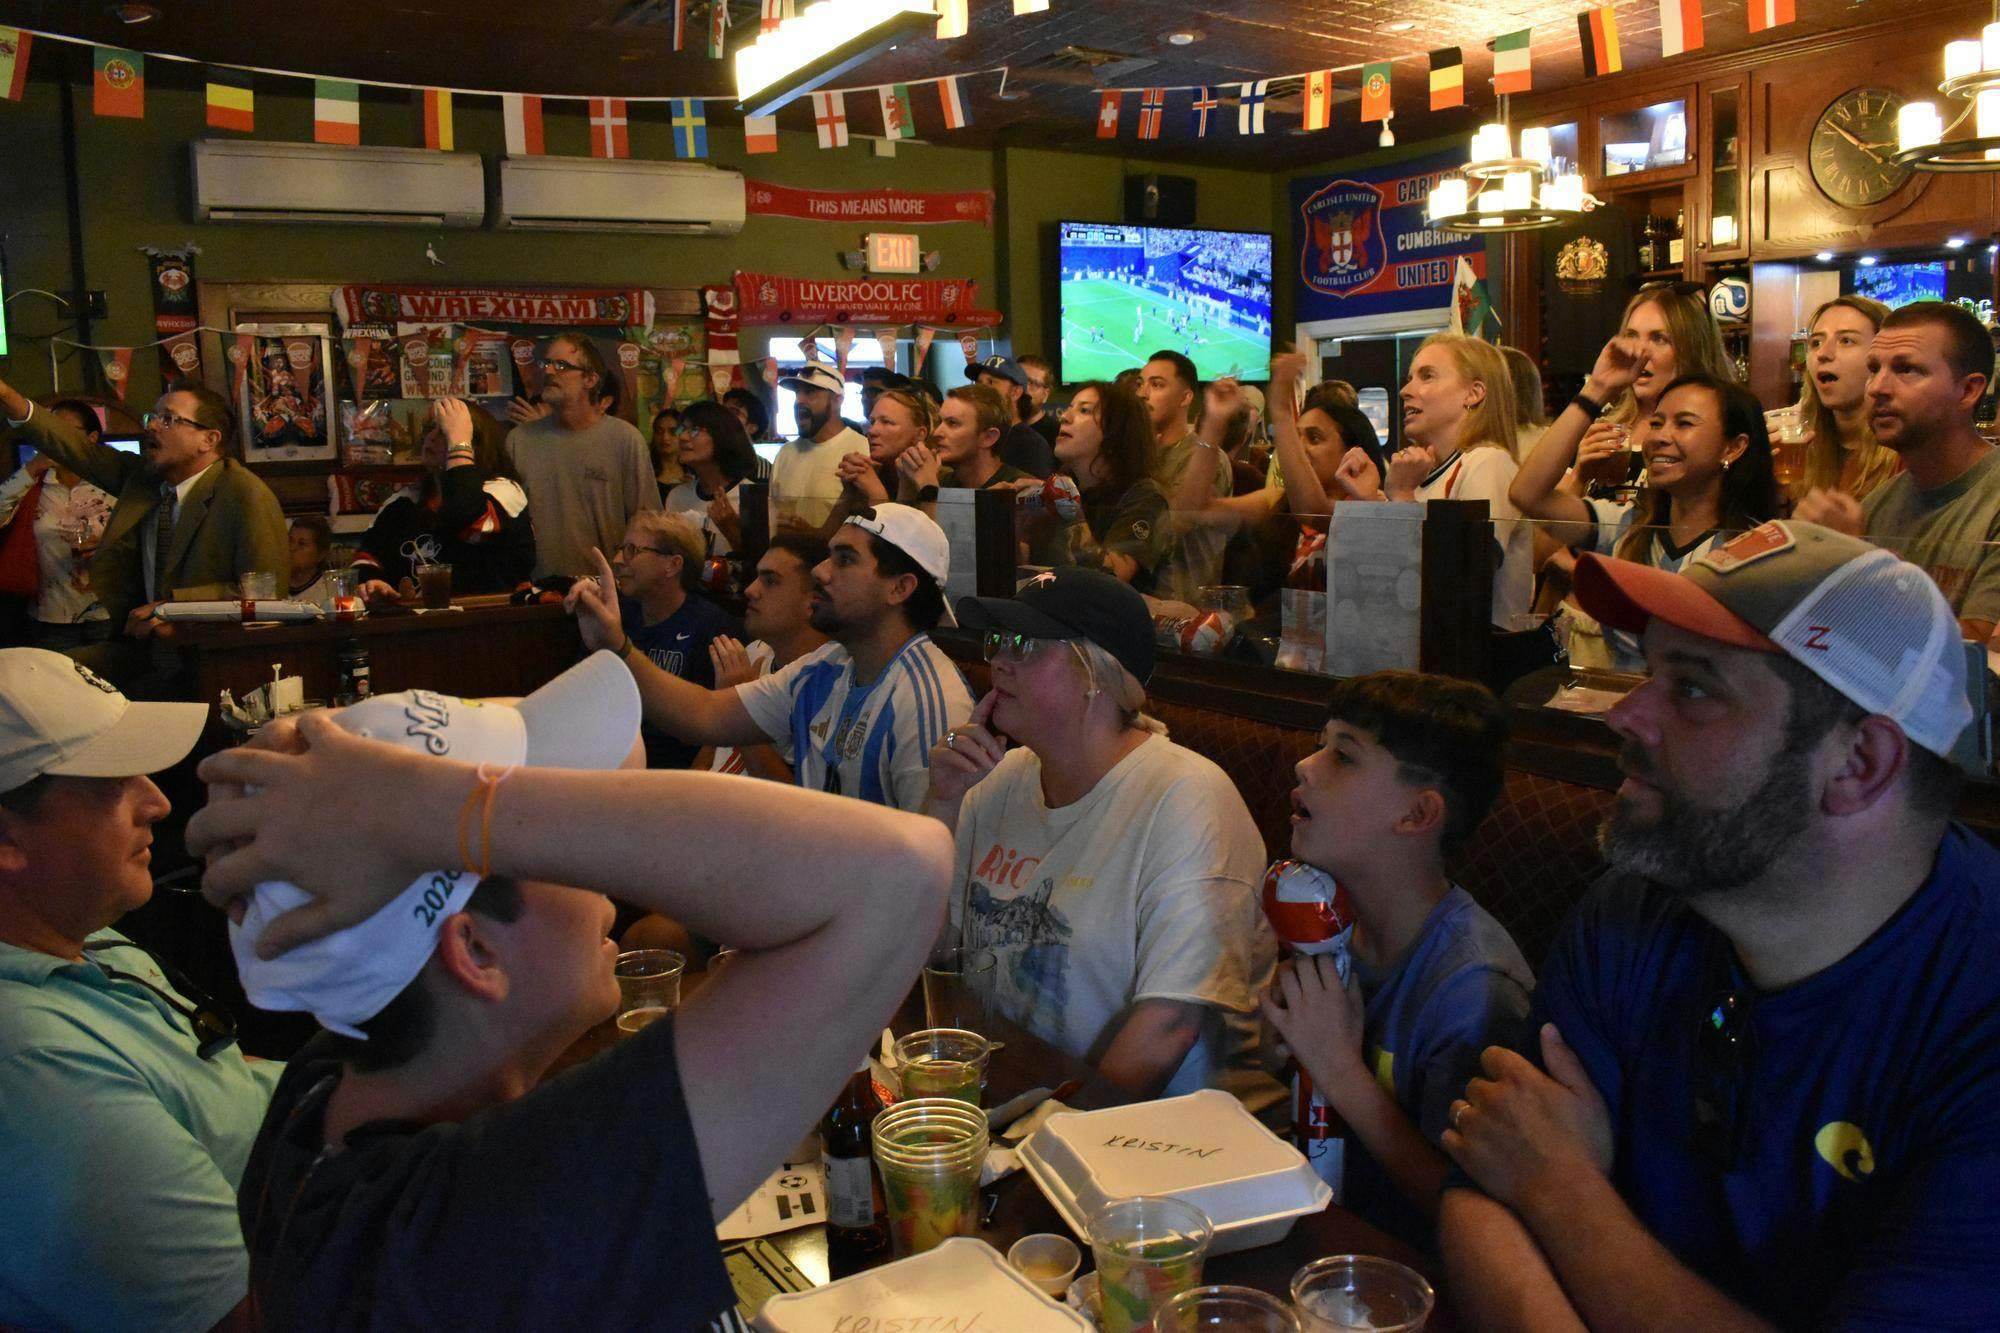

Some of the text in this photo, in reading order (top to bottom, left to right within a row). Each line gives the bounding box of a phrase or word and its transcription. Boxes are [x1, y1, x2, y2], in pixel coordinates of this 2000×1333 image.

[807, 198, 926, 215] THIS MEANS MORE
[1307, 192, 1377, 214] CARLISLE UNITED
[877, 237, 912, 268] EXIT
[1312, 267, 1377, 286] FOOTBALL CLUB
[1396, 259, 1449, 289] UNITED
[800, 283, 923, 302] LIVERPOOL FC
[409, 296, 590, 318] WREXHAM
[342, 328, 391, 339] WREXHAM
[1805, 625, 1831, 651] Z
[1103, 1135, 1224, 1158] KRISTIN
[832, 1311, 983, 1333] KRISTIN
